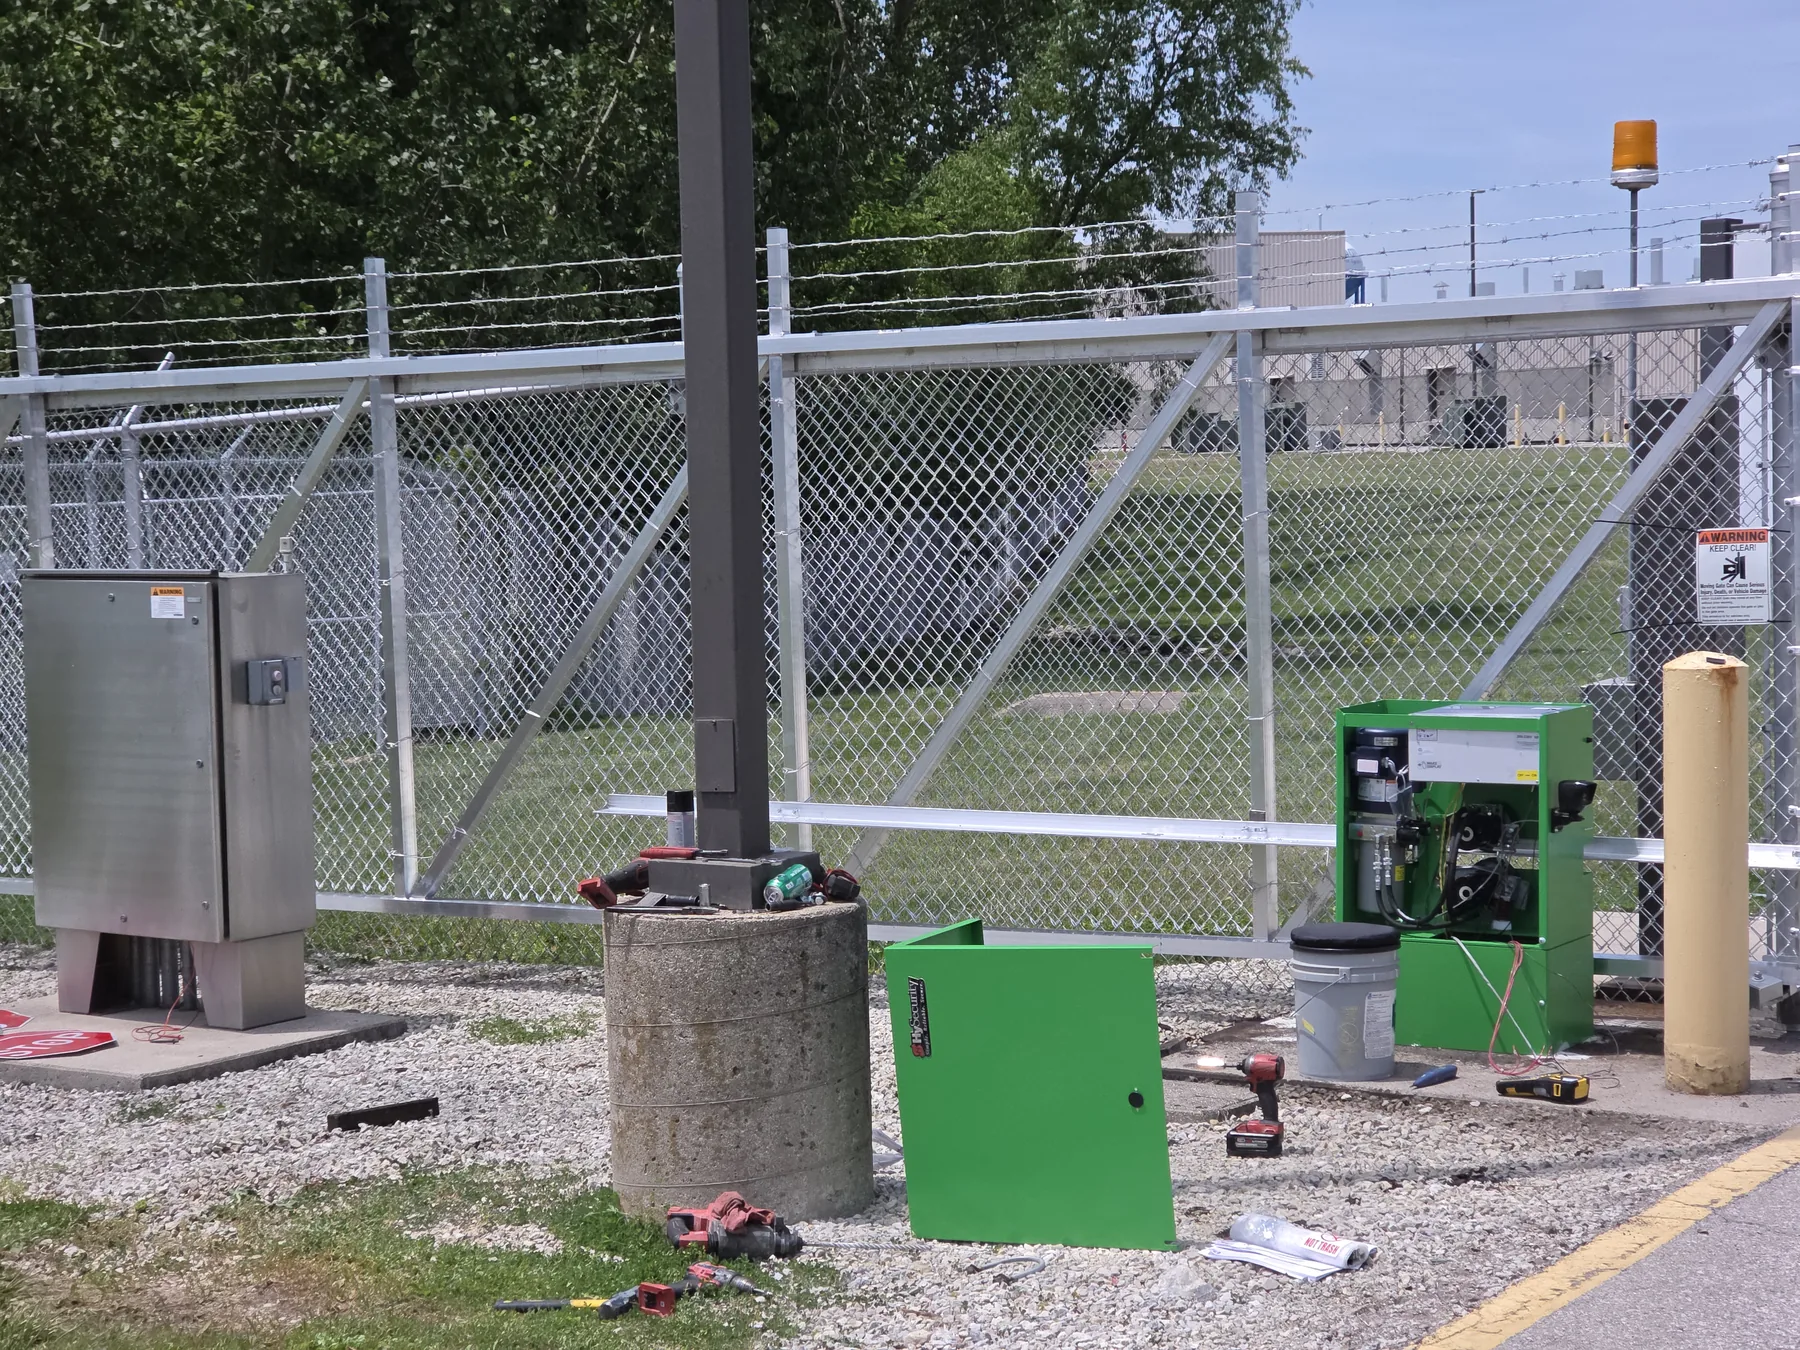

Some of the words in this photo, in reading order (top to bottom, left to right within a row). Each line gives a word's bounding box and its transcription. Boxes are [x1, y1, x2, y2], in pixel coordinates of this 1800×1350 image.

[1711, 532, 1766, 542] WARNING
[908, 980, 923, 1044] HySecurity
[0, 1032, 90, 1056] STOP
[1304, 1237, 1320, 1248] NOT
[1317, 1241, 1340, 1254] TRASH
